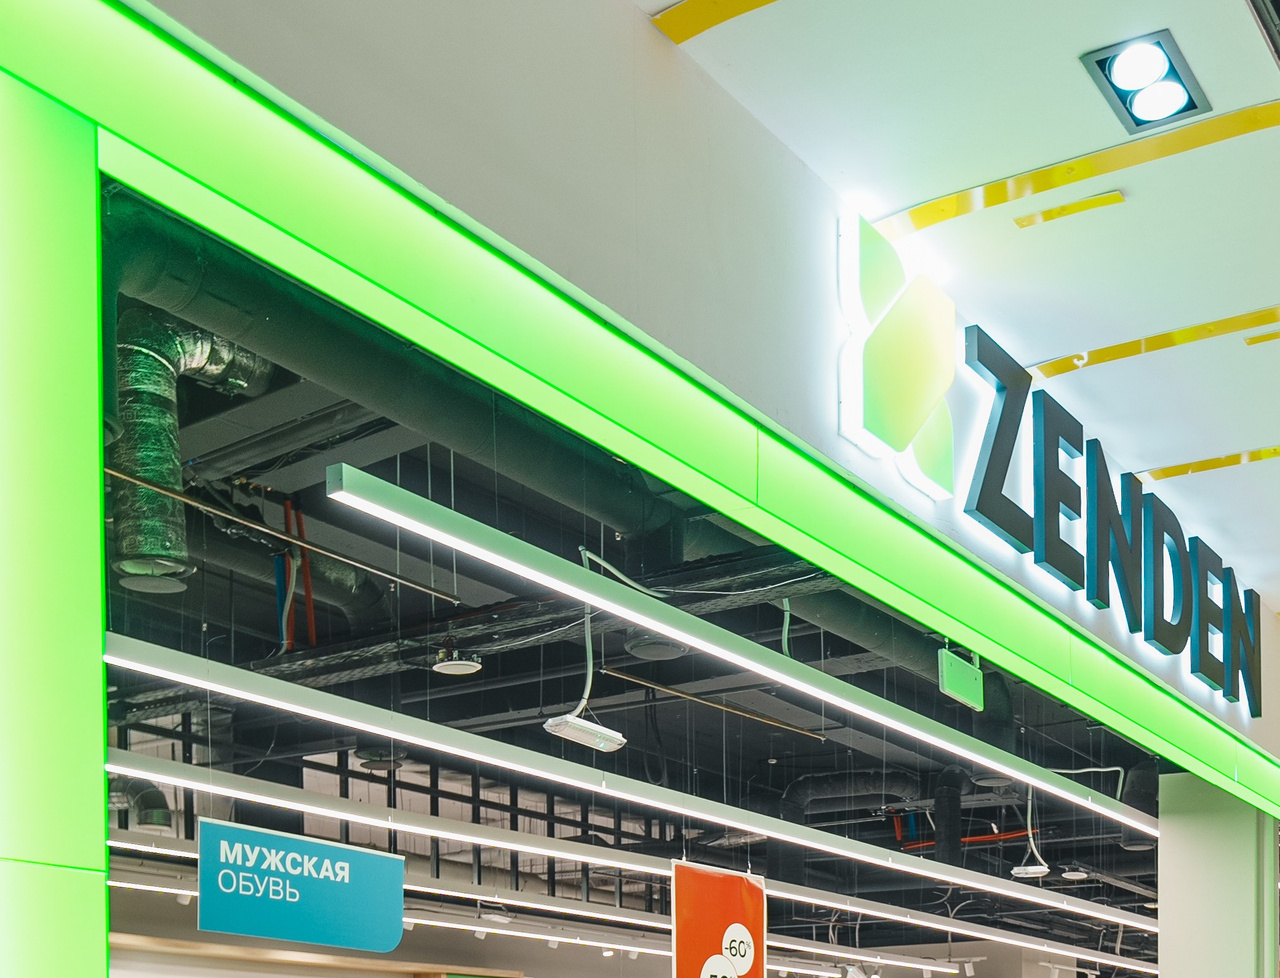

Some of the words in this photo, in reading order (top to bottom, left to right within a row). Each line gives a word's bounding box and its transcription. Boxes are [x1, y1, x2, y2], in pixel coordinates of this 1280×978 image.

[964, 324, 1262, 719] ZENDEN
[219, 839, 350, 883] МУЖСКАЯ
[217, 868, 300, 903] ОБУВЬ
[724, 938, 752, 958] -60%
